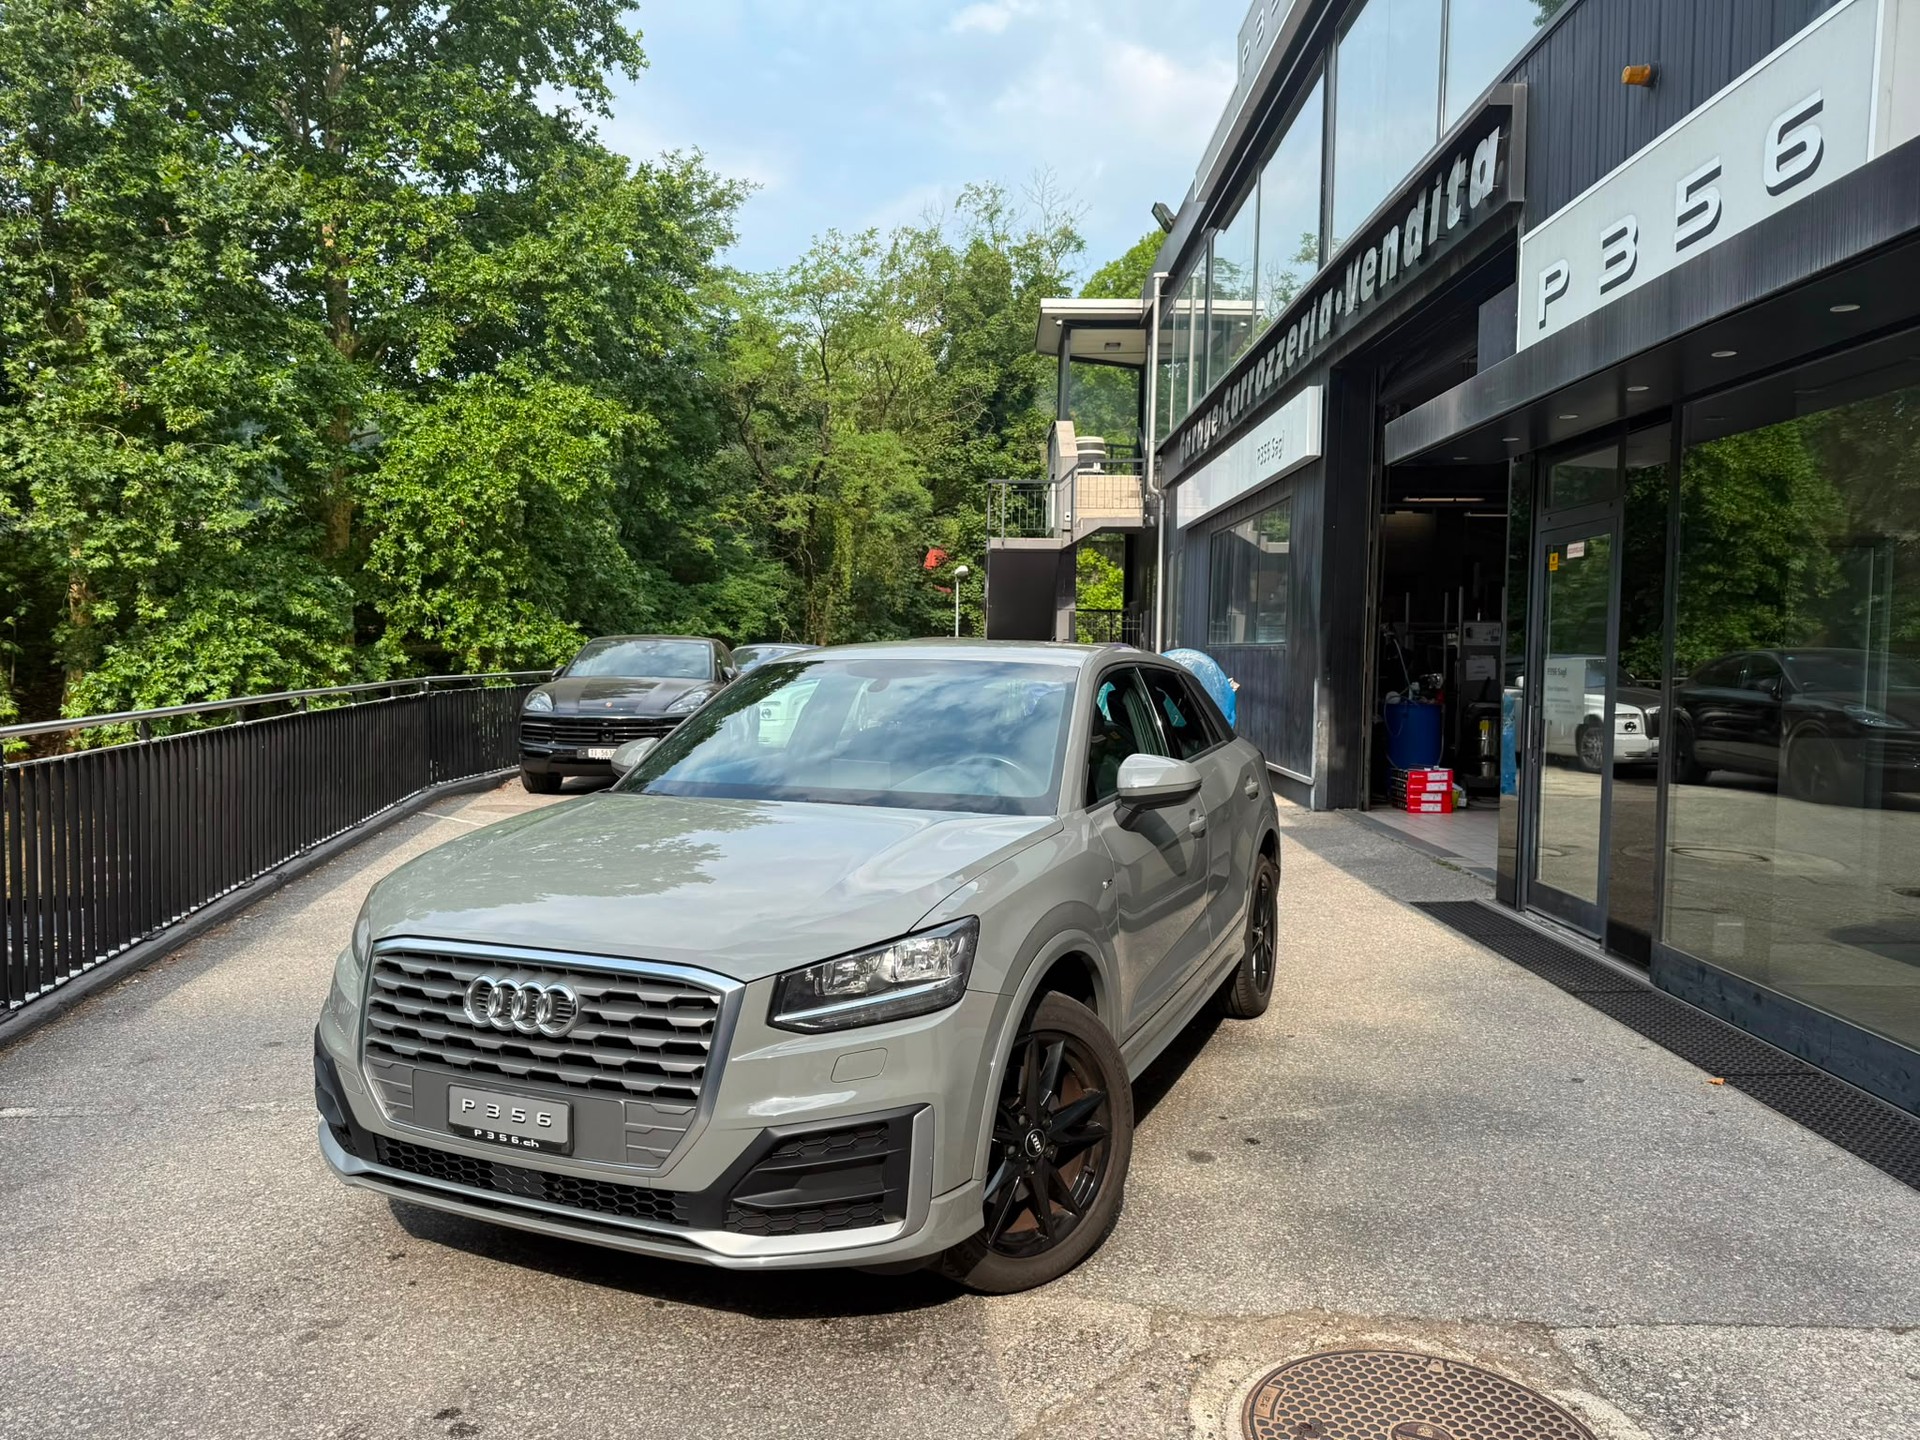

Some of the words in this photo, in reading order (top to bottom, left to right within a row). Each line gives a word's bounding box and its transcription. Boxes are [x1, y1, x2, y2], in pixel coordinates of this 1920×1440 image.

[1538, 88, 1824, 330] P356
[461, 1098, 552, 1127] P356
[474, 1129, 540, 1148] P356.ch
